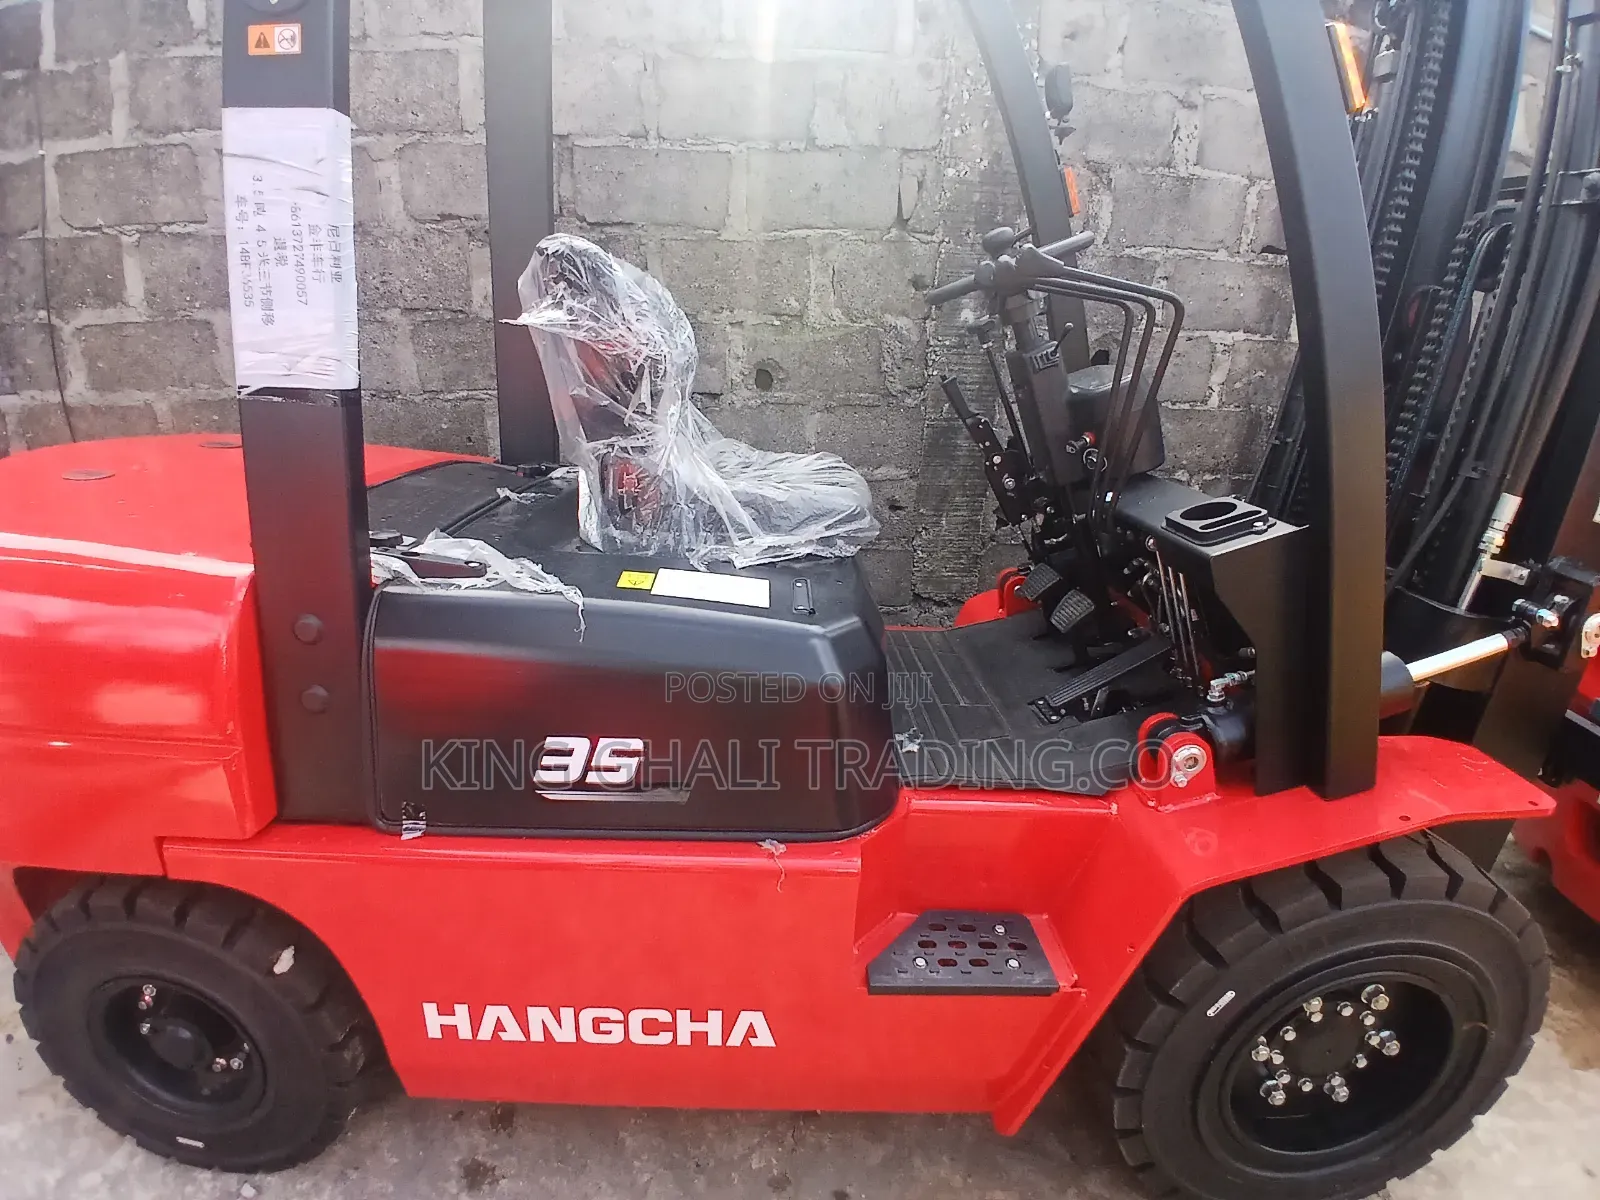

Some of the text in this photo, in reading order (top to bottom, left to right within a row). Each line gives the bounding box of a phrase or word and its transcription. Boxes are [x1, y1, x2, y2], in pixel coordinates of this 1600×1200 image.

[327, 223, 342, 284] 尼日利亚
[533, 736, 645, 784] 35
[422, 1002, 776, 1047] HANGCHA
